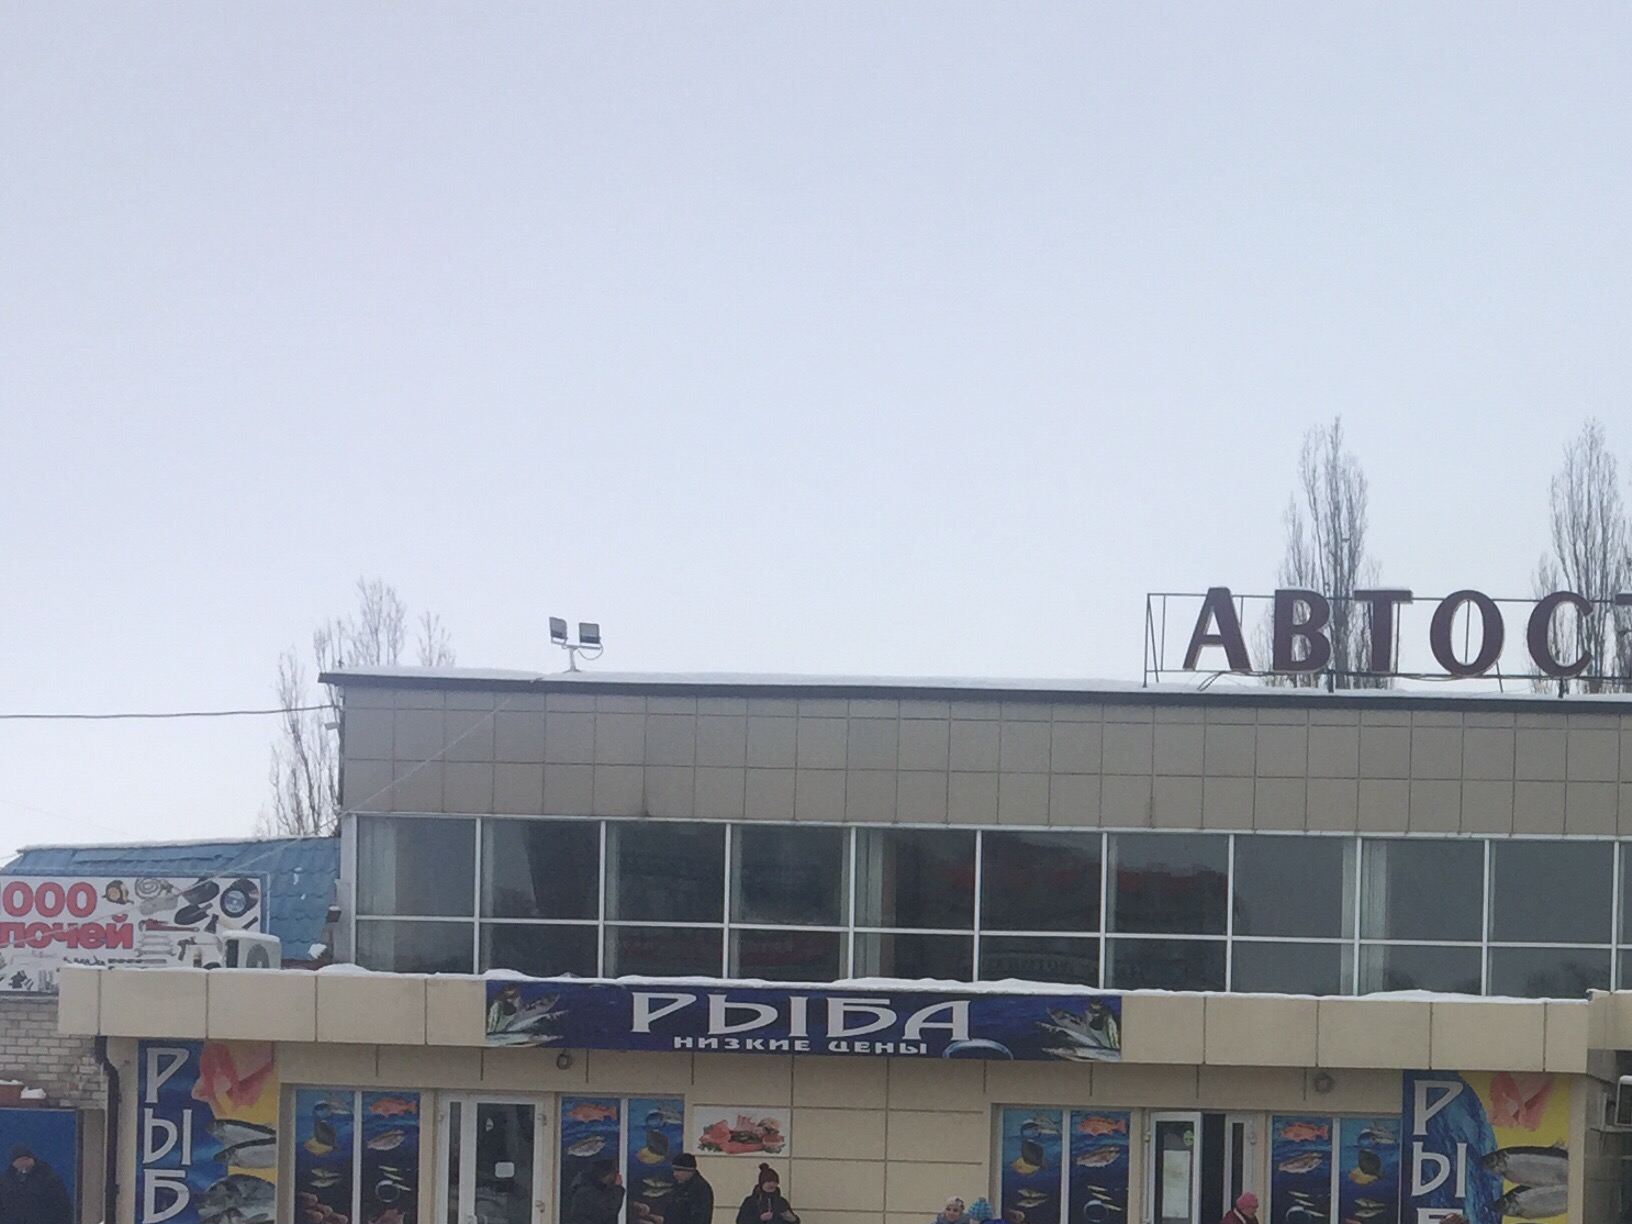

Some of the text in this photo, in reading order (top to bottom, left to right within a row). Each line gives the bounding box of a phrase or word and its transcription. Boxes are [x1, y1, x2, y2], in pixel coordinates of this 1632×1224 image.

[0, 880, 98, 918] 000
[629, 990, 974, 1042] РЫБА
[673, 1036, 929, 1056] НИЗКИЕ ЦЕНЫ
